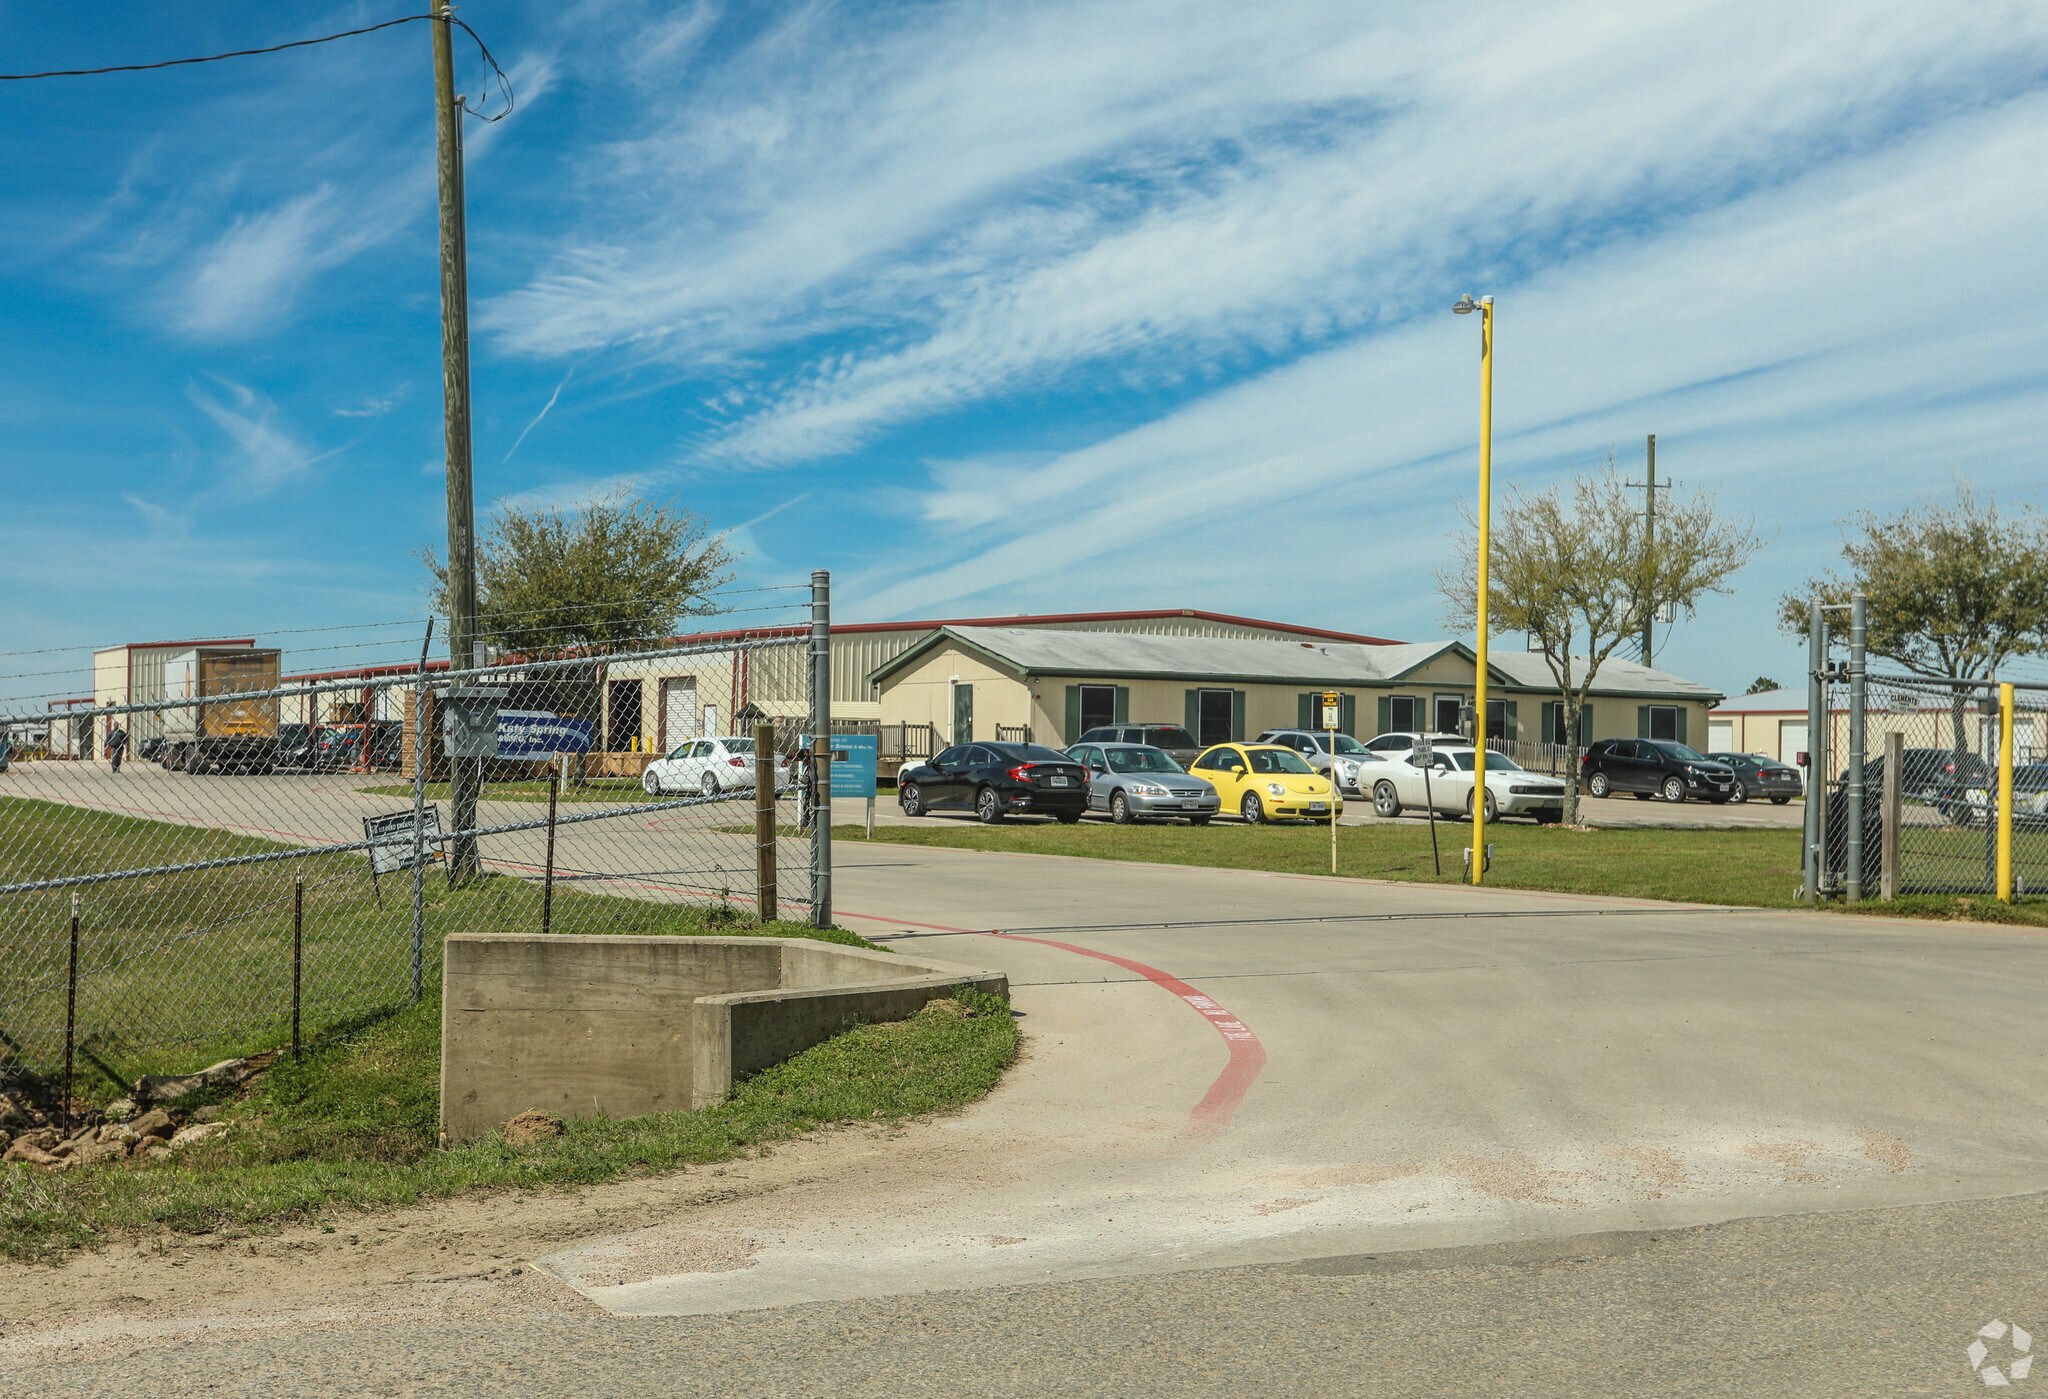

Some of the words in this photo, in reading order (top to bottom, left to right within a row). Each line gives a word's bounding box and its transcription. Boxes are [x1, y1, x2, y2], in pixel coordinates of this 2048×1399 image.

[1890, 694, 1918, 706] CLEMENTS
[497, 723, 525, 736] Katy
[530, 724, 568, 737] Spring
